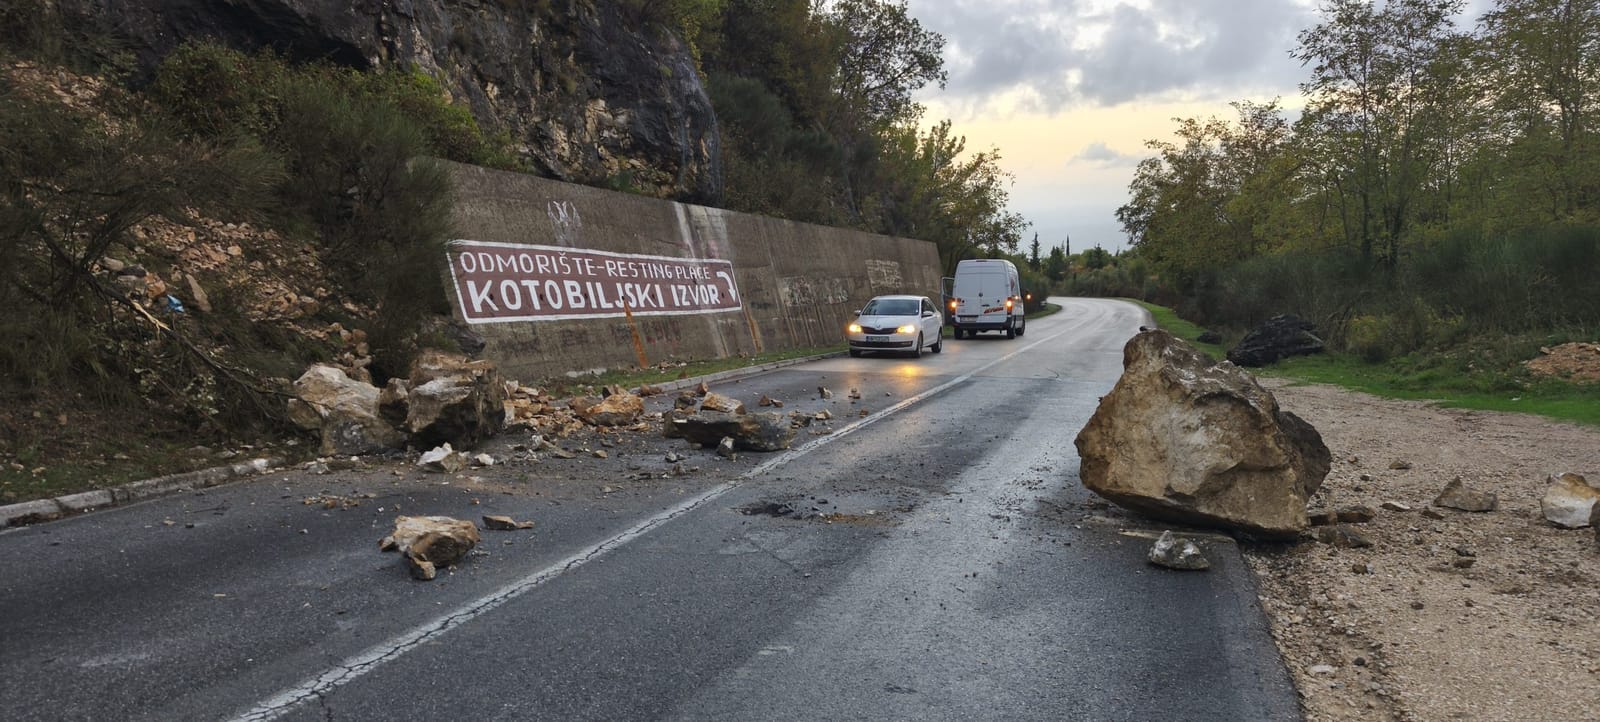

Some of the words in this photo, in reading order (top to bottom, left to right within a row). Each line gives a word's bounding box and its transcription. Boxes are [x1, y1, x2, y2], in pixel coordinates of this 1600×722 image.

[675, 265, 711, 280] PLACE
[466, 279, 665, 313] KOTOBILJSKI
[670, 284, 721, 307] IZVOR
